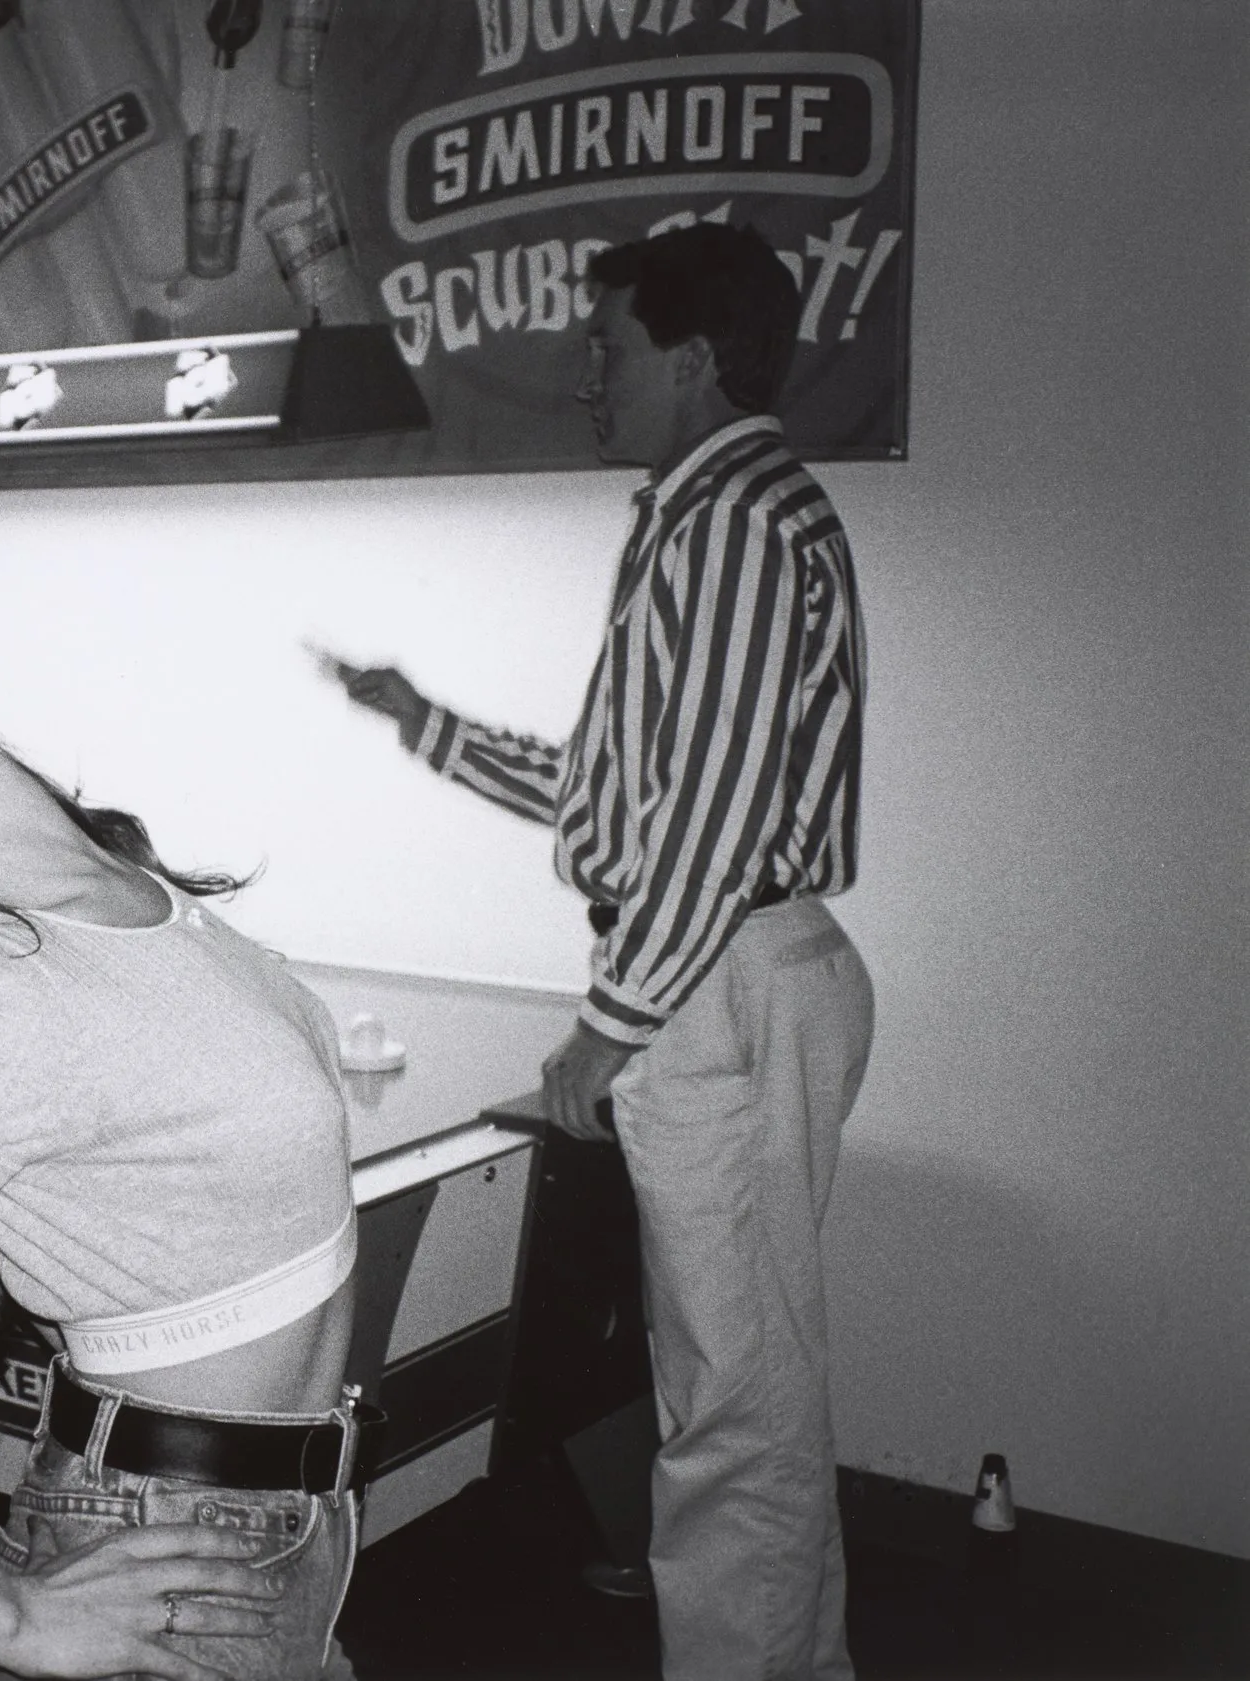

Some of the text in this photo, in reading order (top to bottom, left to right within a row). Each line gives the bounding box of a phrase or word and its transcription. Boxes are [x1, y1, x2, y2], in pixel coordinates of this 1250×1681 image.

[431, 84, 831, 205] SMIRNOFF
[80, 1304, 246, 1354] CRAZY HORSE
